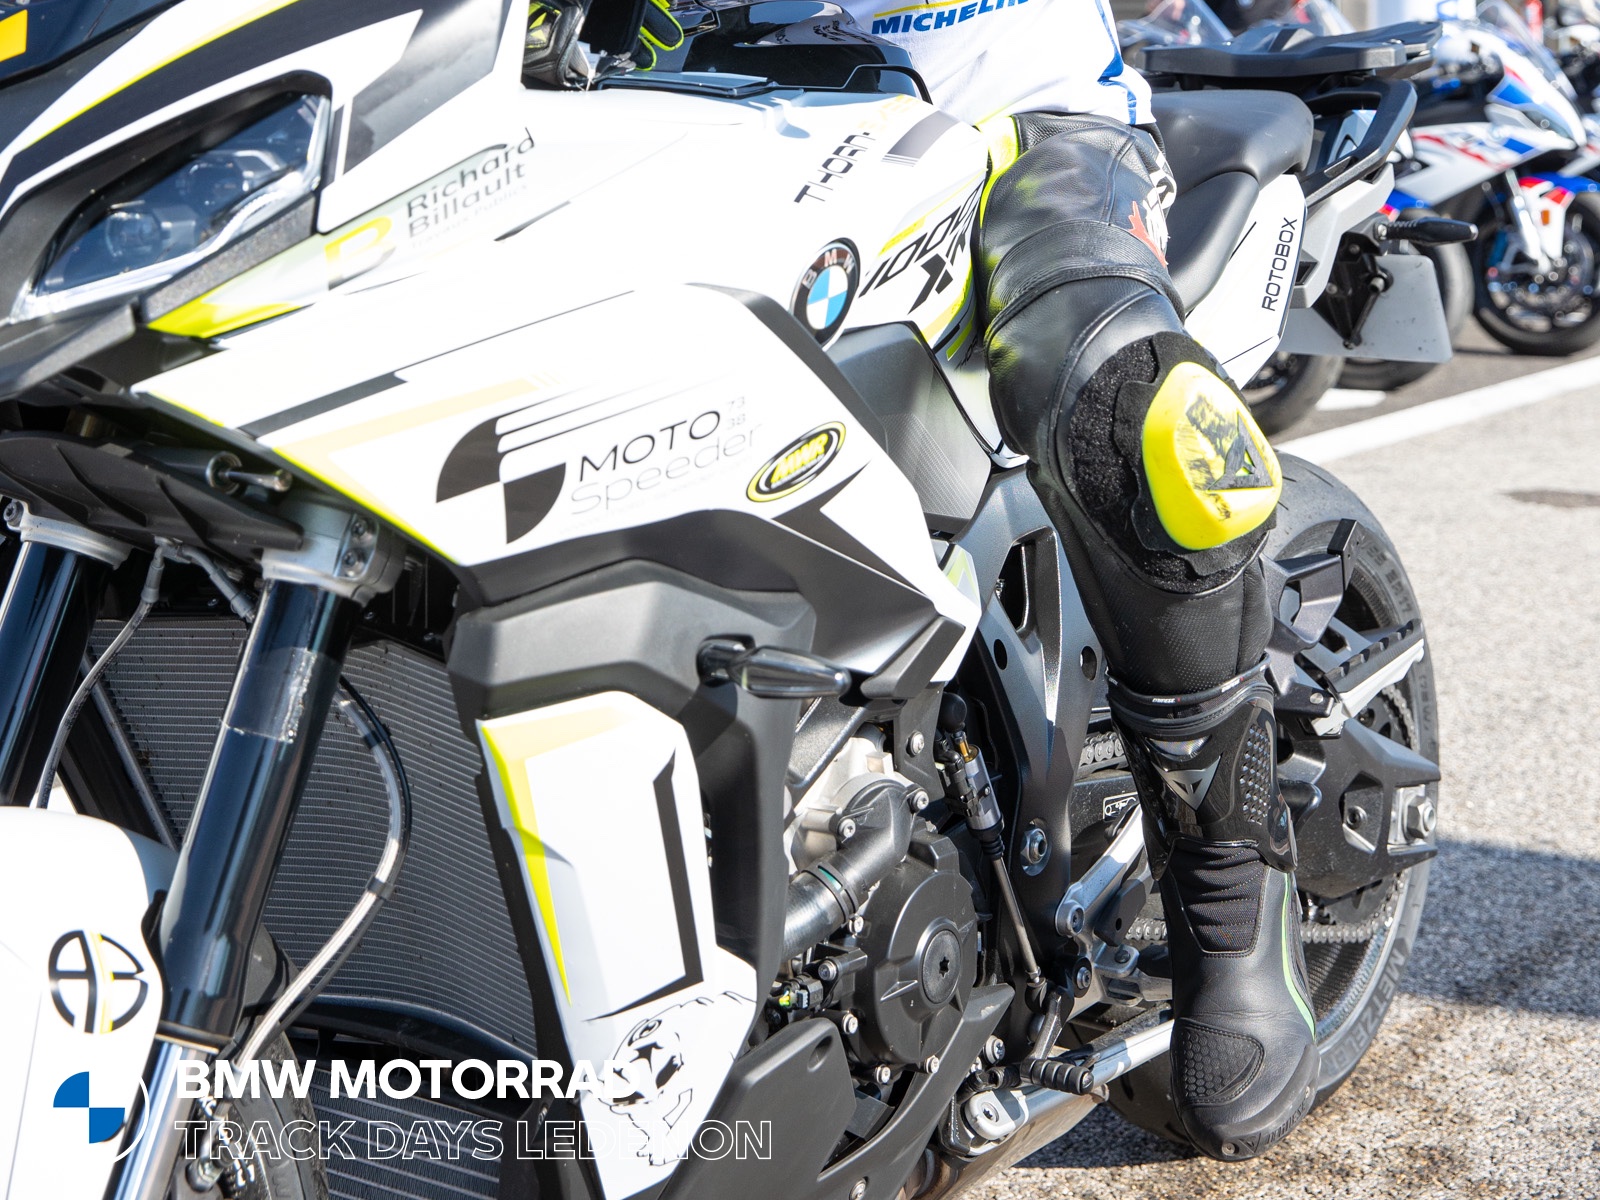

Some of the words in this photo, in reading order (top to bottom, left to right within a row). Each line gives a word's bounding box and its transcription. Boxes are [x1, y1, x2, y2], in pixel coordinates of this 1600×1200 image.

[407, 127, 535, 218] Richard
[409, 163, 525, 238] Billault
[802, 248, 856, 290] BMW
[1262, 217, 1297, 311] ROTOBOX
[571, 424, 763, 516] Speeder
[580, 410, 721, 482] MOTO
